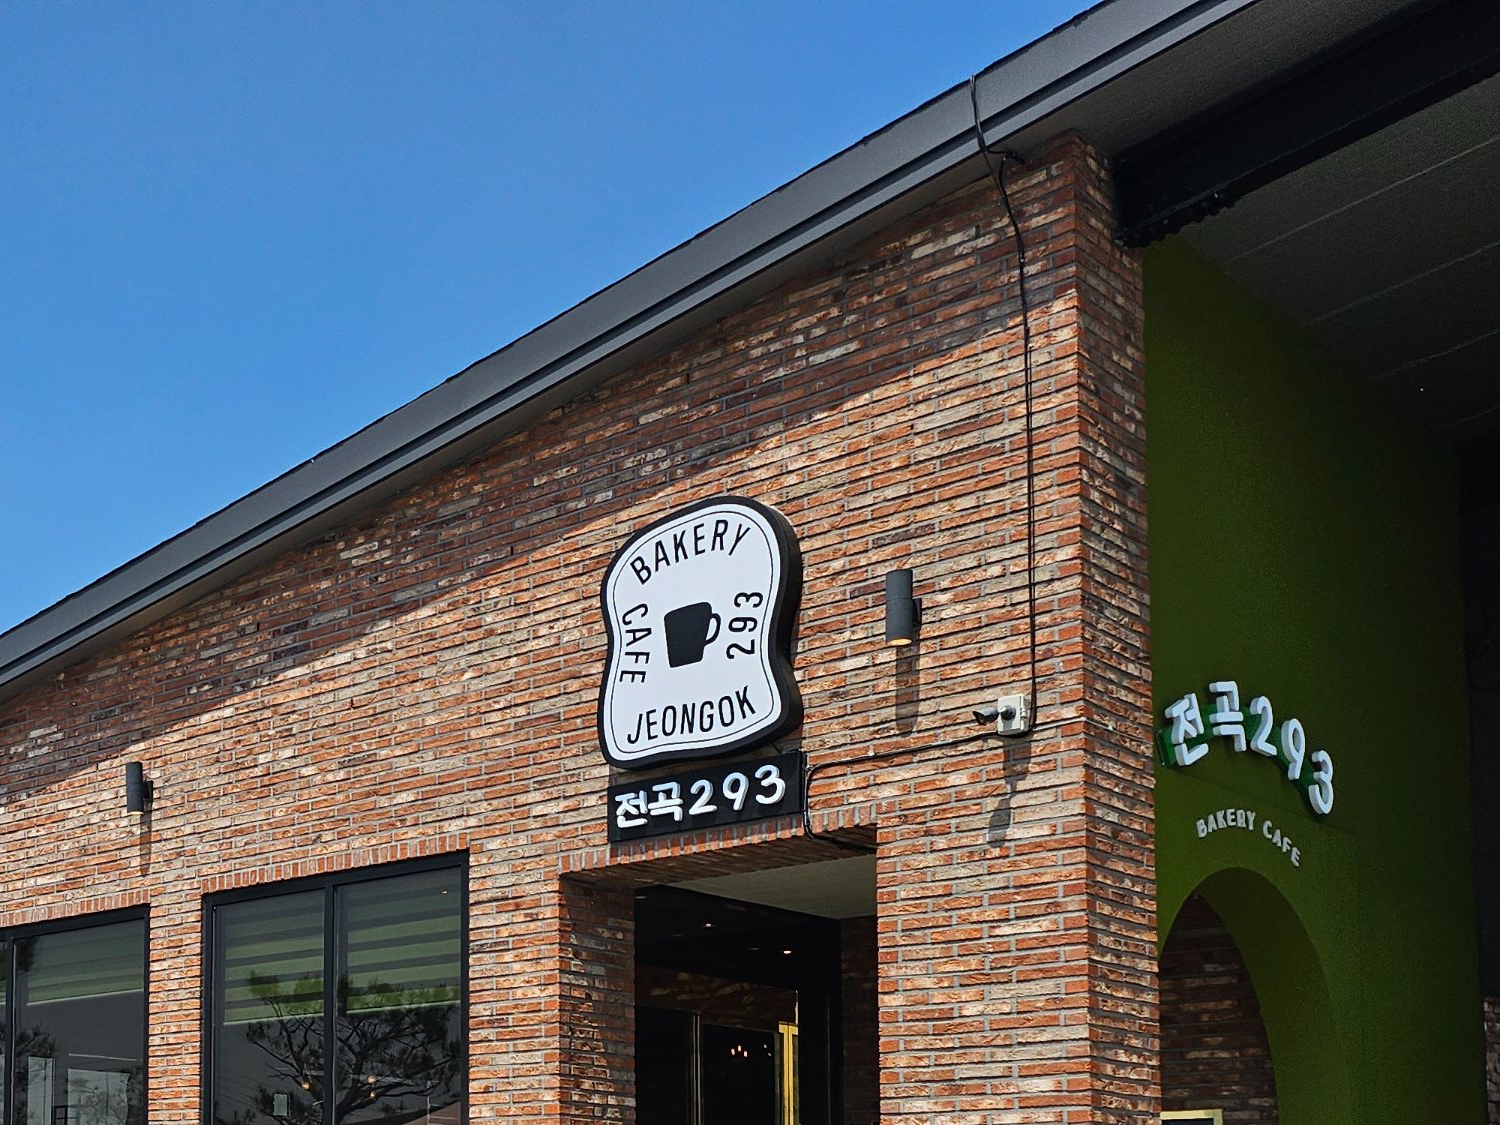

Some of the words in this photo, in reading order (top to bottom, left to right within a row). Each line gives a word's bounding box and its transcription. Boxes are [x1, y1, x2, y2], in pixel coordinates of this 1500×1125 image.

[630, 519, 751, 586] BAKERY
[620, 603, 651, 685] CAFE
[726, 591, 764, 661] 293
[627, 685, 757, 745] JEONGOK
[1164, 680, 1335, 815] 전곡293
[614, 764, 787, 829] 전곡293
[1196, 808, 1256, 838] BAKERY
[1262, 820, 1301, 867] CAFE
